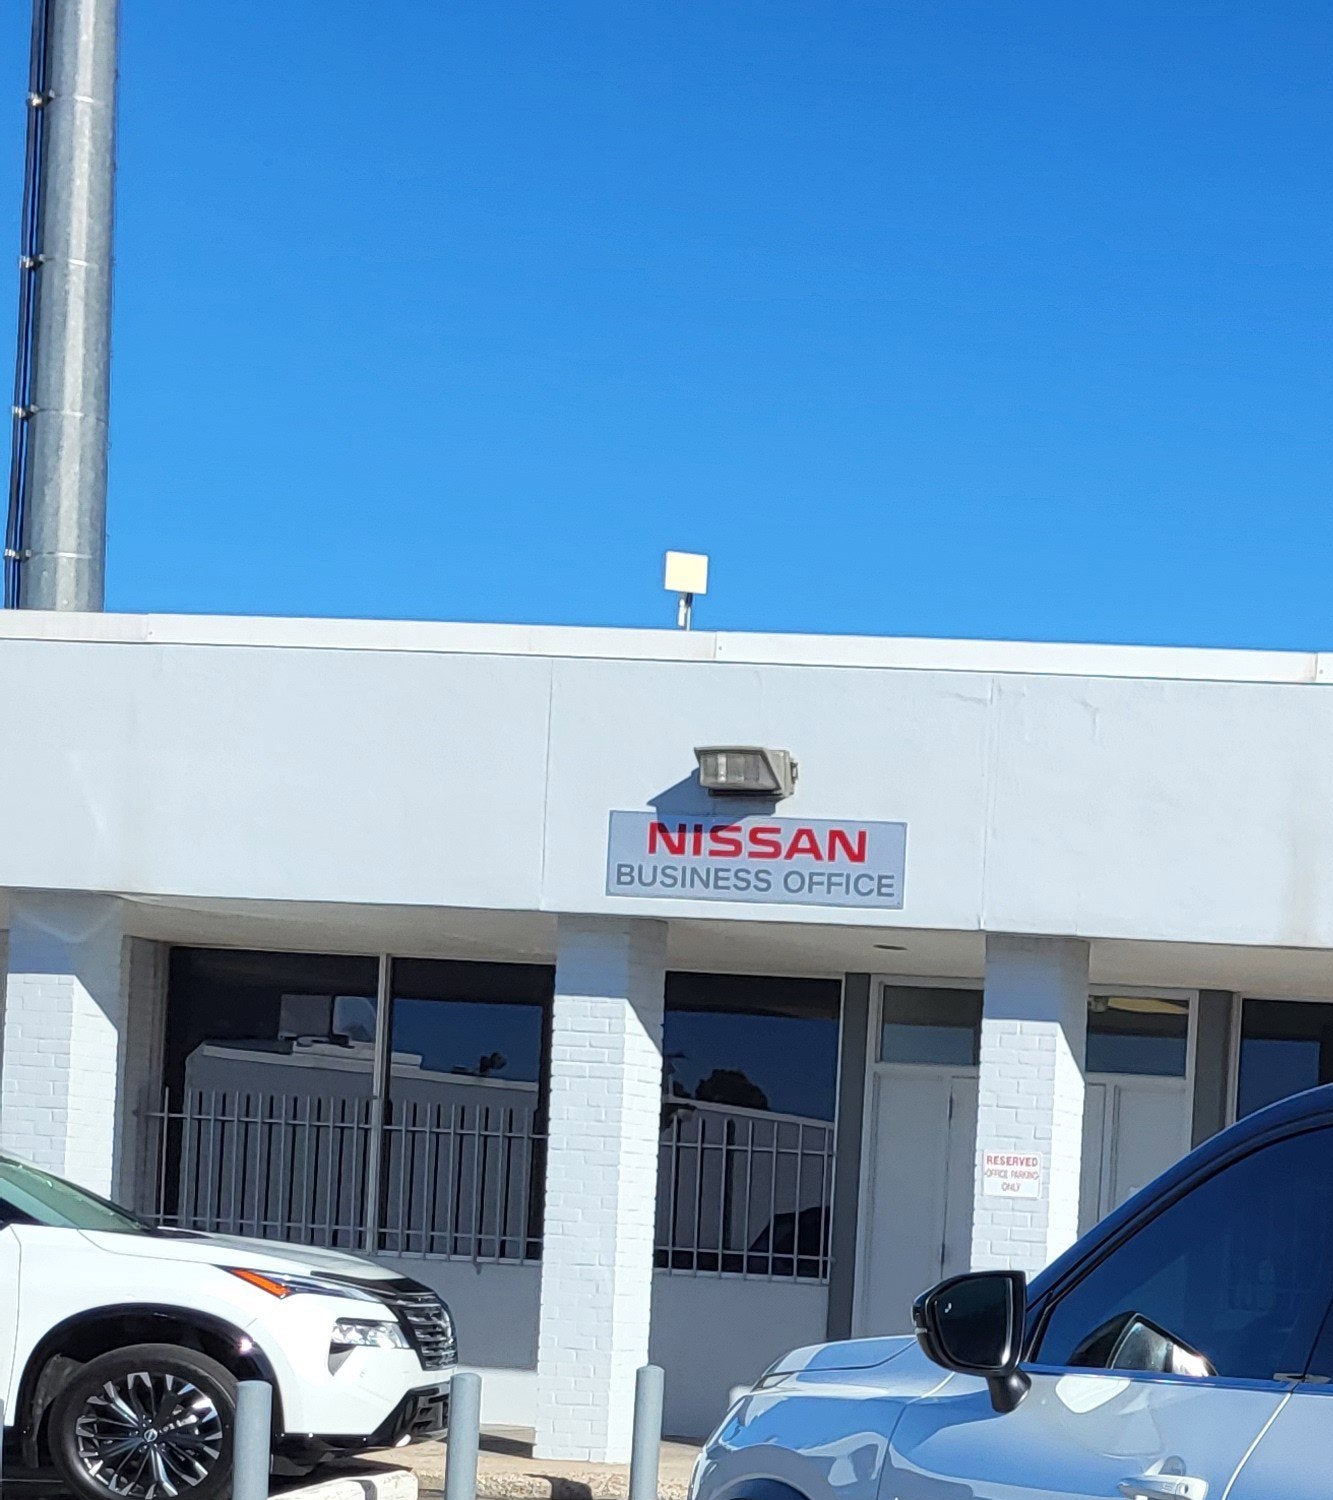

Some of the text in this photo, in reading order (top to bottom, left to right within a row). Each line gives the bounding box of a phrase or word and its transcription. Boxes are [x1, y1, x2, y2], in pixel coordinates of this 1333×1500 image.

[648, 821, 867, 863] NISSAN
[616, 863, 894, 897] BUSINESS OFFICE
[986, 1155, 1038, 1167] RESERVED
[986, 1168, 1008, 1179] OFFICE
